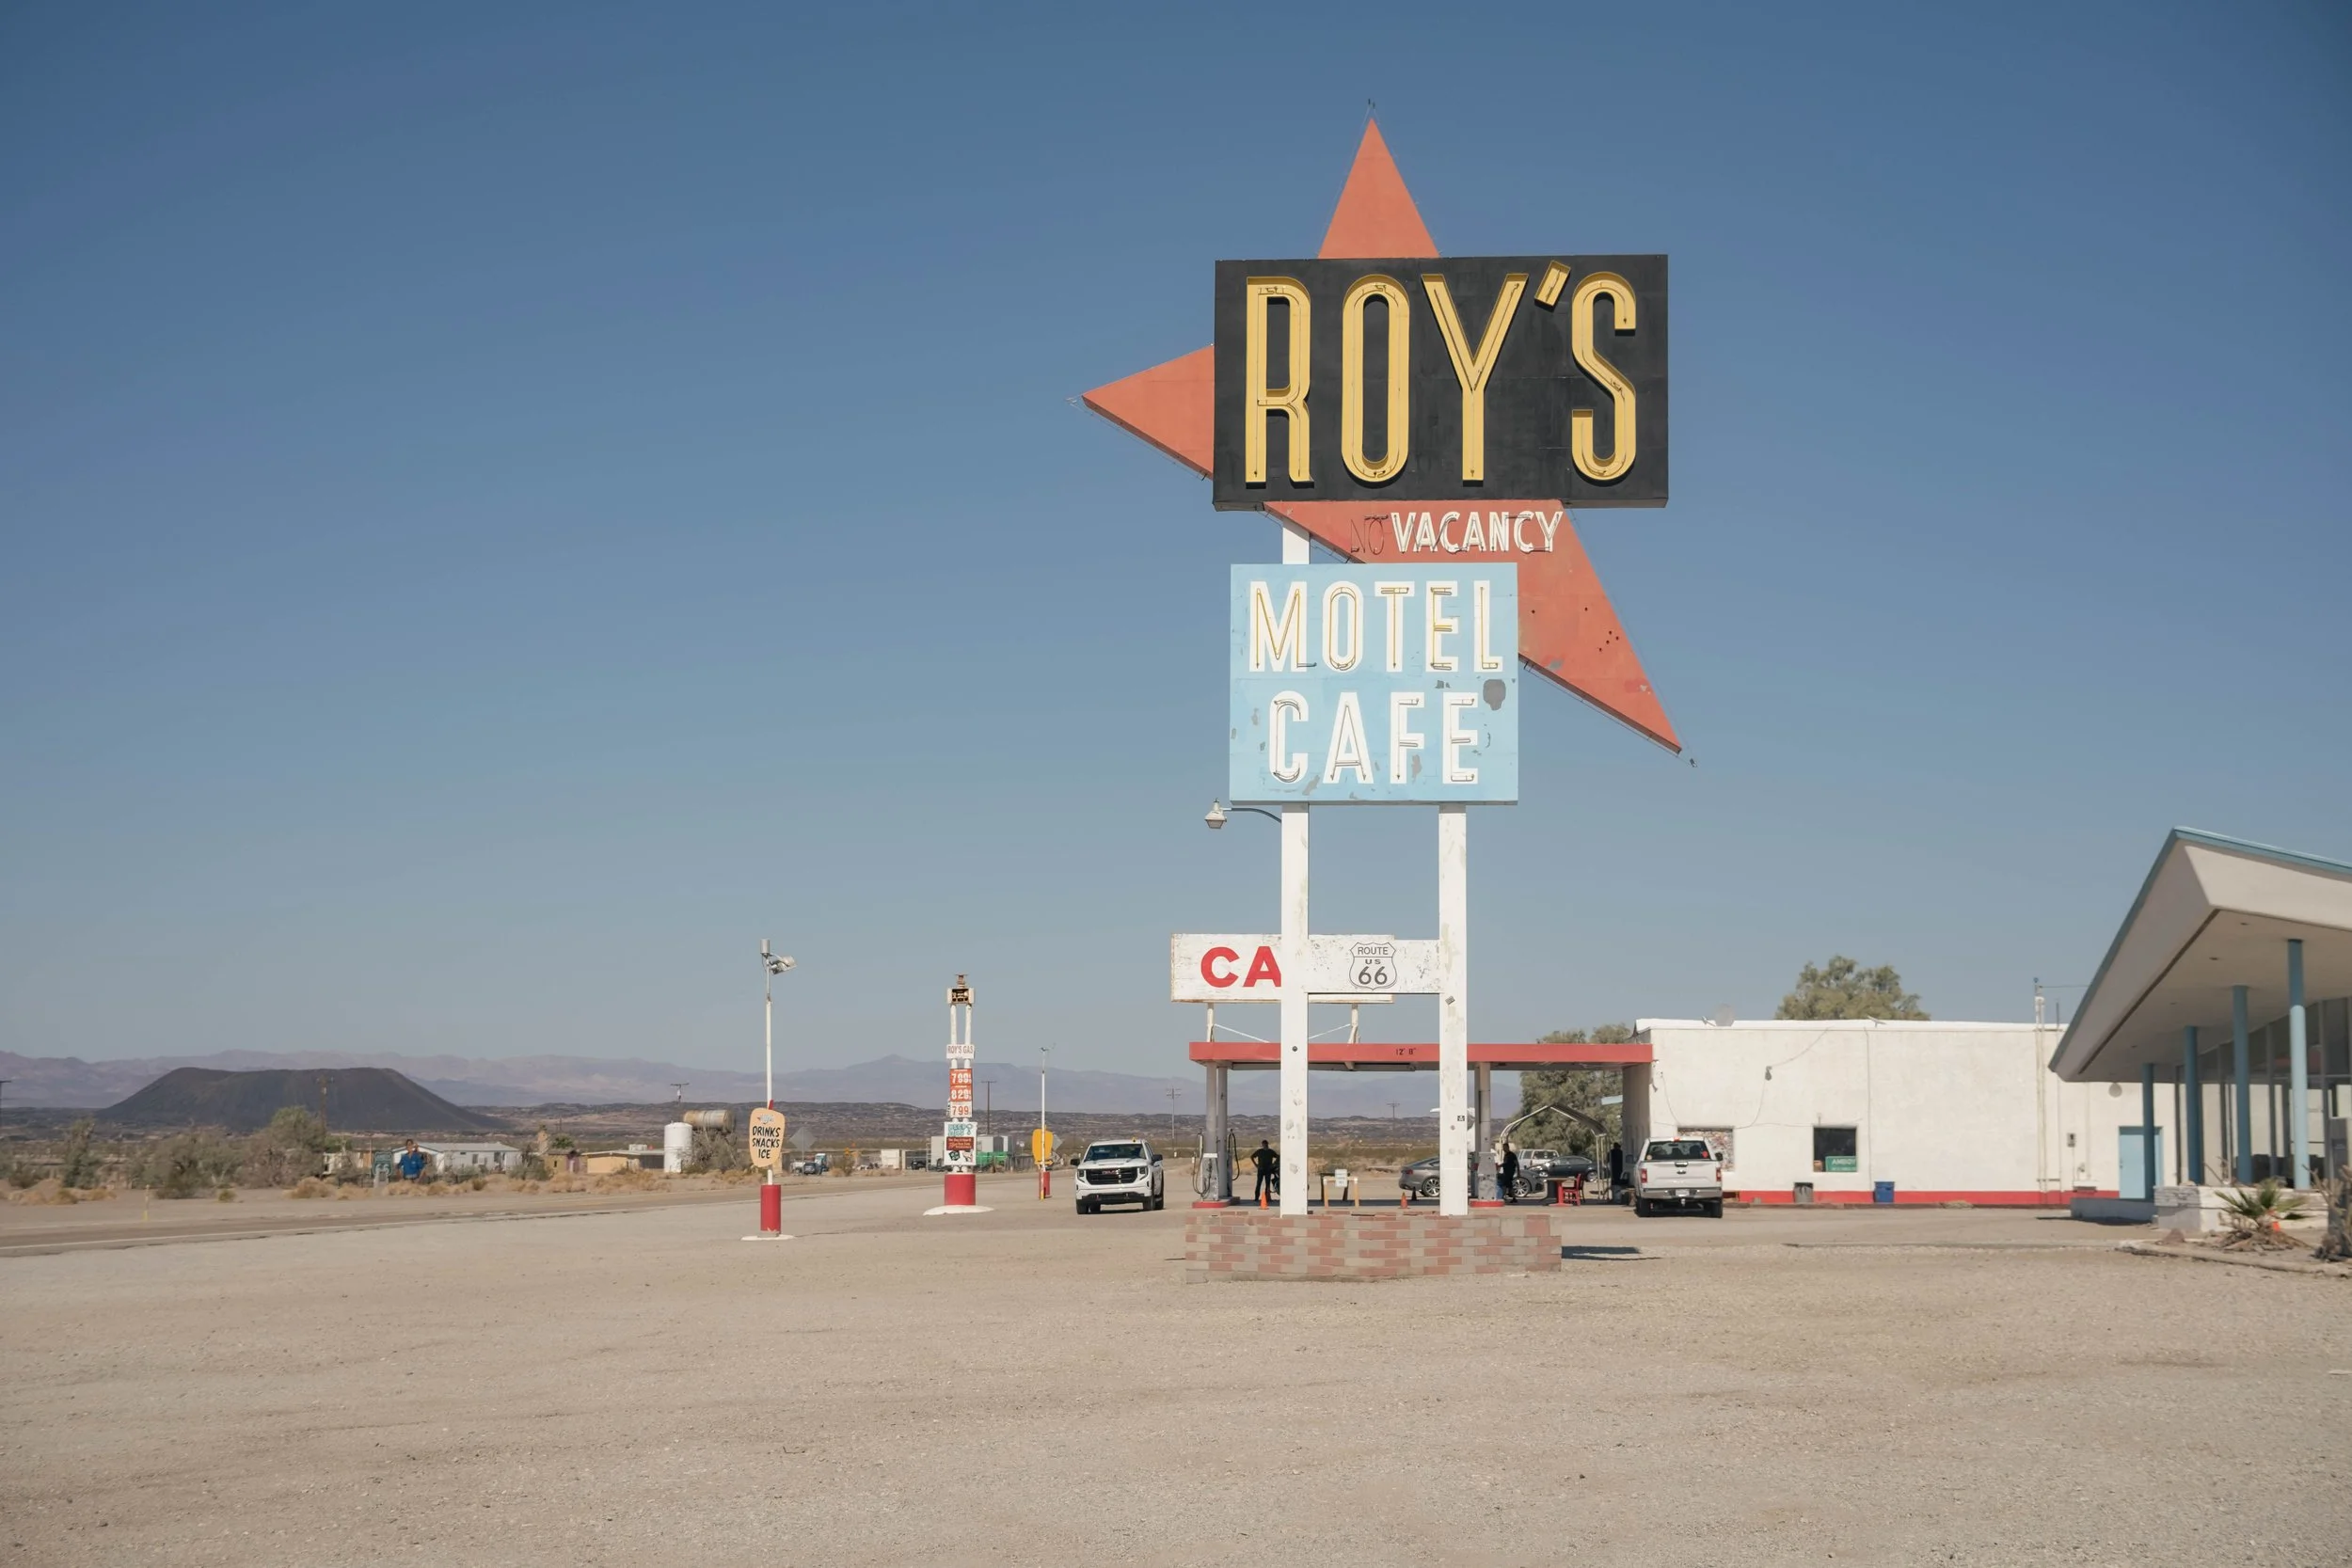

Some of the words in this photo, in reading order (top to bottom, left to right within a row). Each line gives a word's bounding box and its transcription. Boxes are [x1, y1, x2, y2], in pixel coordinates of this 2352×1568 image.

[1246, 261, 1636, 483] ROY'S
[1391, 511, 1564, 554] VACANCY
[1249, 580, 1503, 673] MOTEL
[1268, 690, 1479, 785] CAFE
[1358, 946, 1389, 956] ROUTE
[1358, 966, 1388, 985] 66
[947, 1045, 961, 1053] ROY'S
[963, 1045, 974, 1053] GAS
[753, 1126, 781, 1137] DRINKS
[753, 1137, 780, 1148] SNACKS
[758, 1149, 771, 1159] ICE
